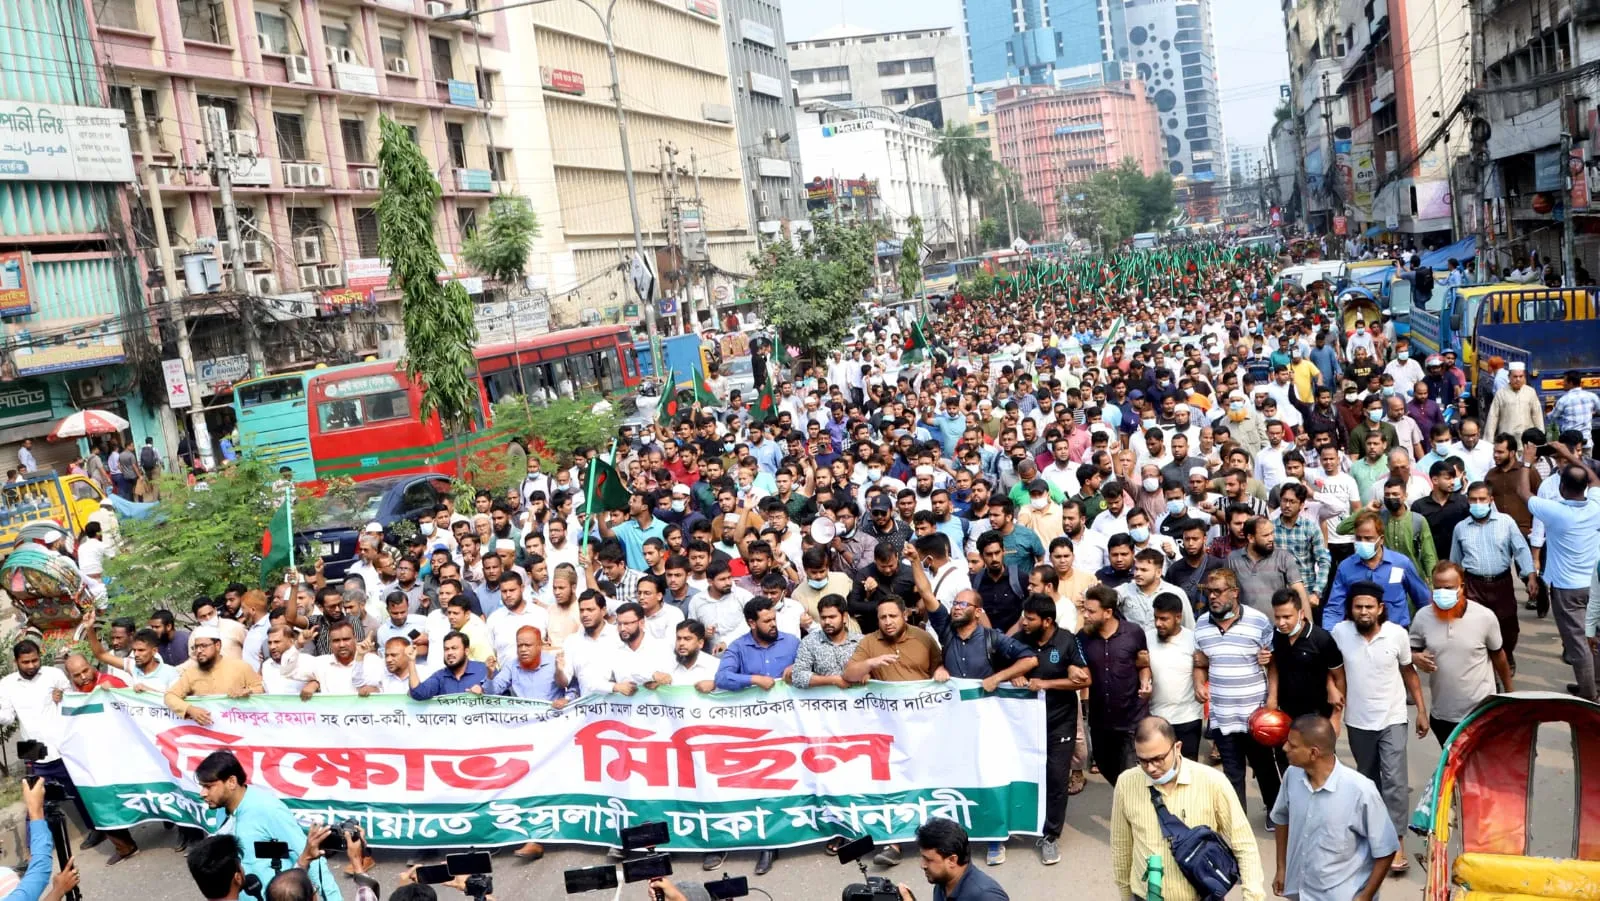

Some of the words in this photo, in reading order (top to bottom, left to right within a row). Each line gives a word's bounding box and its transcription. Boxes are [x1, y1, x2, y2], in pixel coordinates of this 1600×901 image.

[37, 108, 64, 134] লিঃ
[220, 707, 269, 727] শফিকুর
[274, 711, 316, 725] রহমান
[321, 713, 340, 727] সহ
[416, 712, 457, 727] আলেম
[463, 712, 528, 725] ওলামাদের
[575, 701, 607, 717] মিথ্যা
[636, 705, 685, 720] প্রত্যাহার
[690, 708, 702, 719] ও
[709, 699, 795, 720] কেয়ারটেকার
[799, 698, 848, 712] সরকার
[853, 693, 898, 712] প্রতিষ্ঠার
[904, 690, 954, 711] দাবিতে
[574, 720, 895, 790] মিছিল
[488, 798, 638, 838] ইসলামী
[665, 807, 778, 841] ঢাকা
